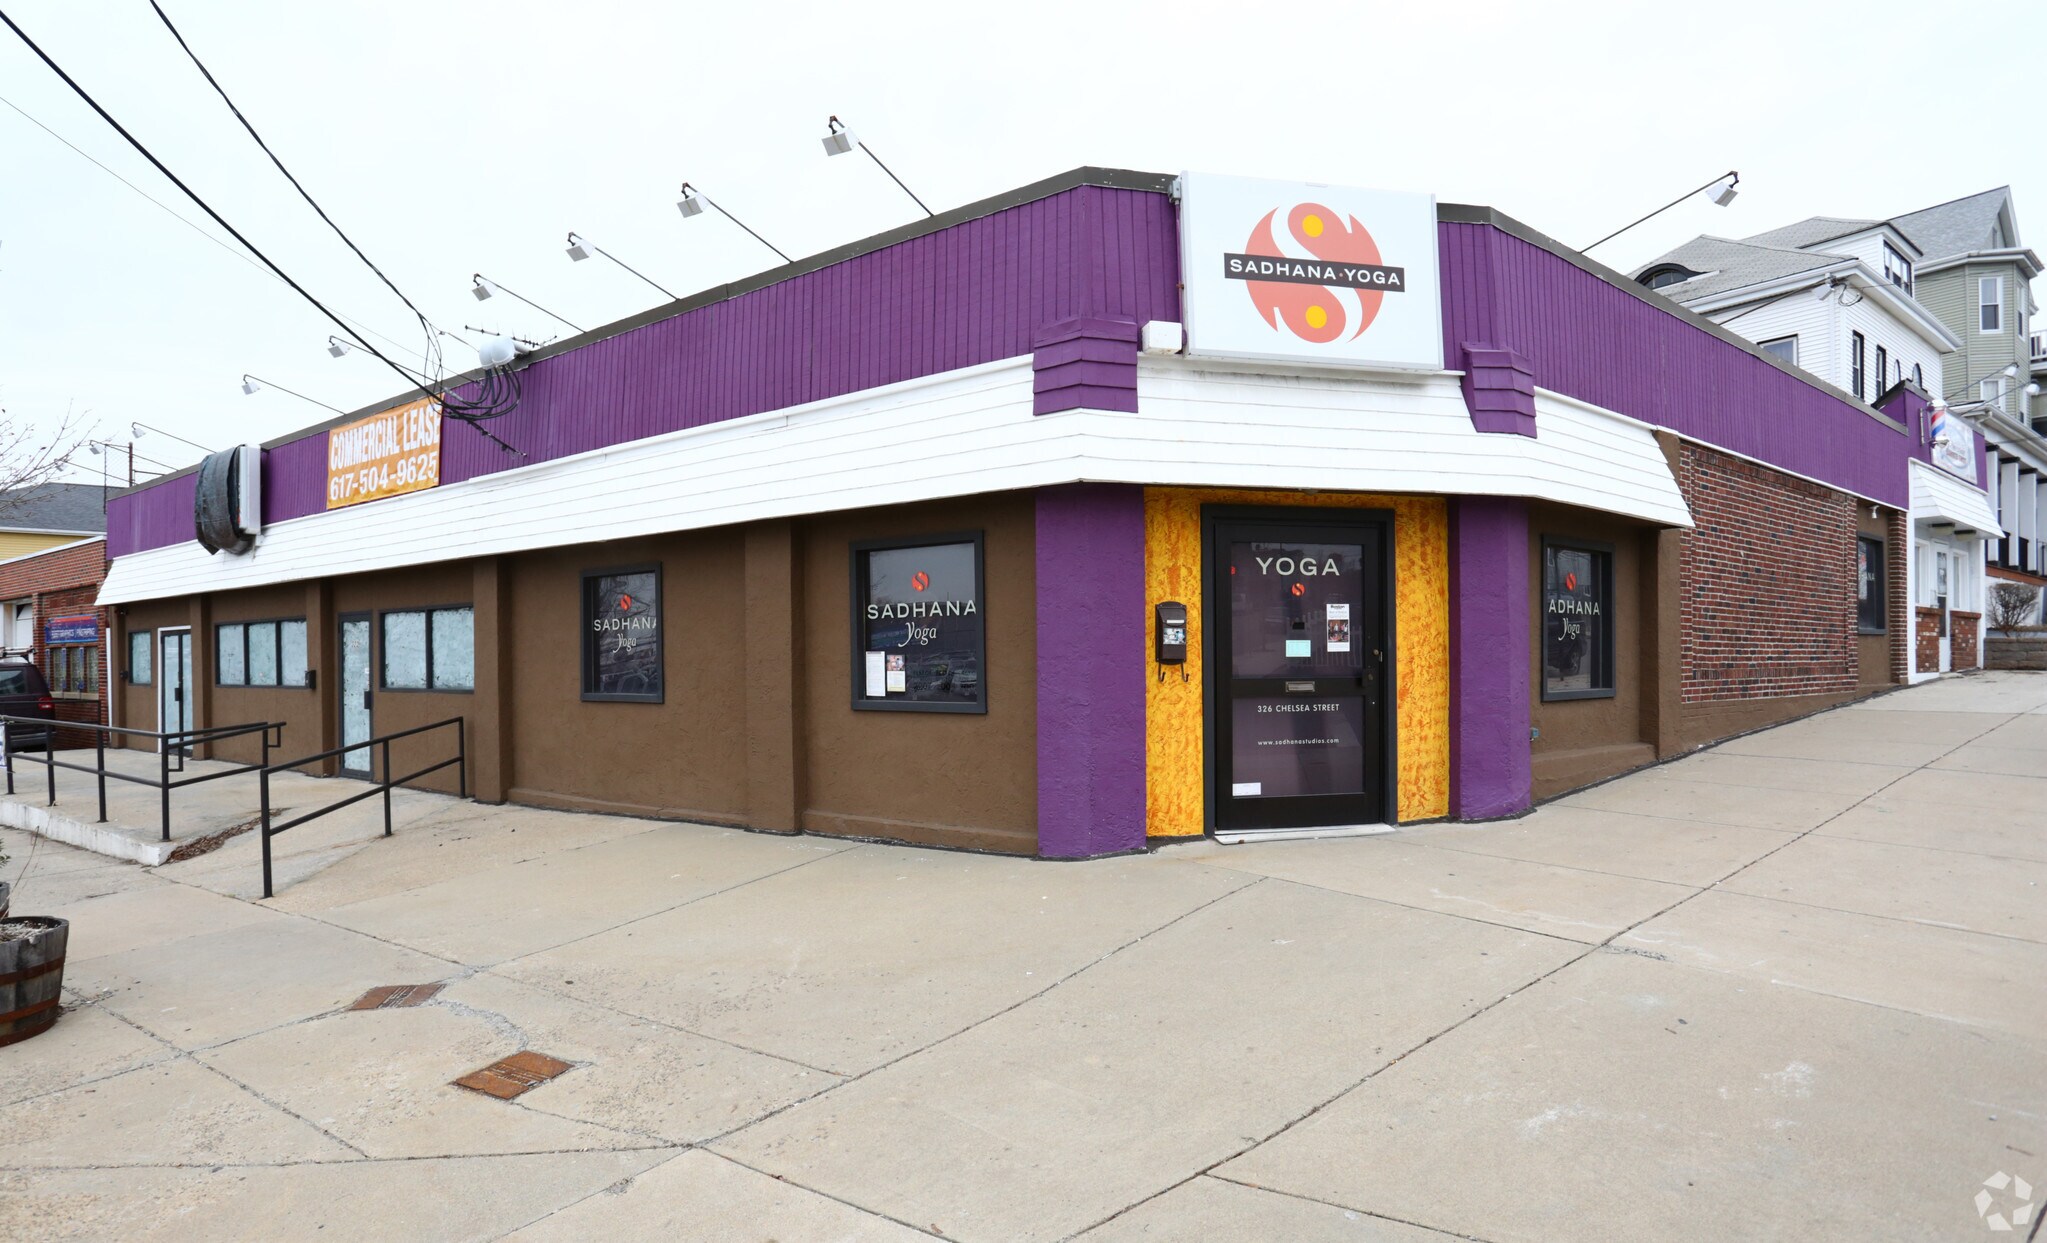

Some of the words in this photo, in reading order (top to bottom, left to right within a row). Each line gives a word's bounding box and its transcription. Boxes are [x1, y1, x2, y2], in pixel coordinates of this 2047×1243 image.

[1229, 258, 1337, 280] SADHANA
[1343, 268, 1401, 286] YOGA
[331, 415, 400, 471] COMMERCIAL
[403, 403, 442, 450] LEASE
[330, 452, 438, 500] 617-504-9625
[1255, 556, 1340, 576] YOGA
[867, 599, 977, 620] SADHANA
[897, 621, 937, 648] Yoga
[1558, 618, 1580, 640] Yoga
[612, 632, 637, 653] Yoga
[1257, 705, 1273, 713] 326
[1275, 704, 1310, 712] CHELSEA
[1313, 703, 1340, 712] STREET
[1257, 738, 1340, 746] www.sadhanastudios.com
